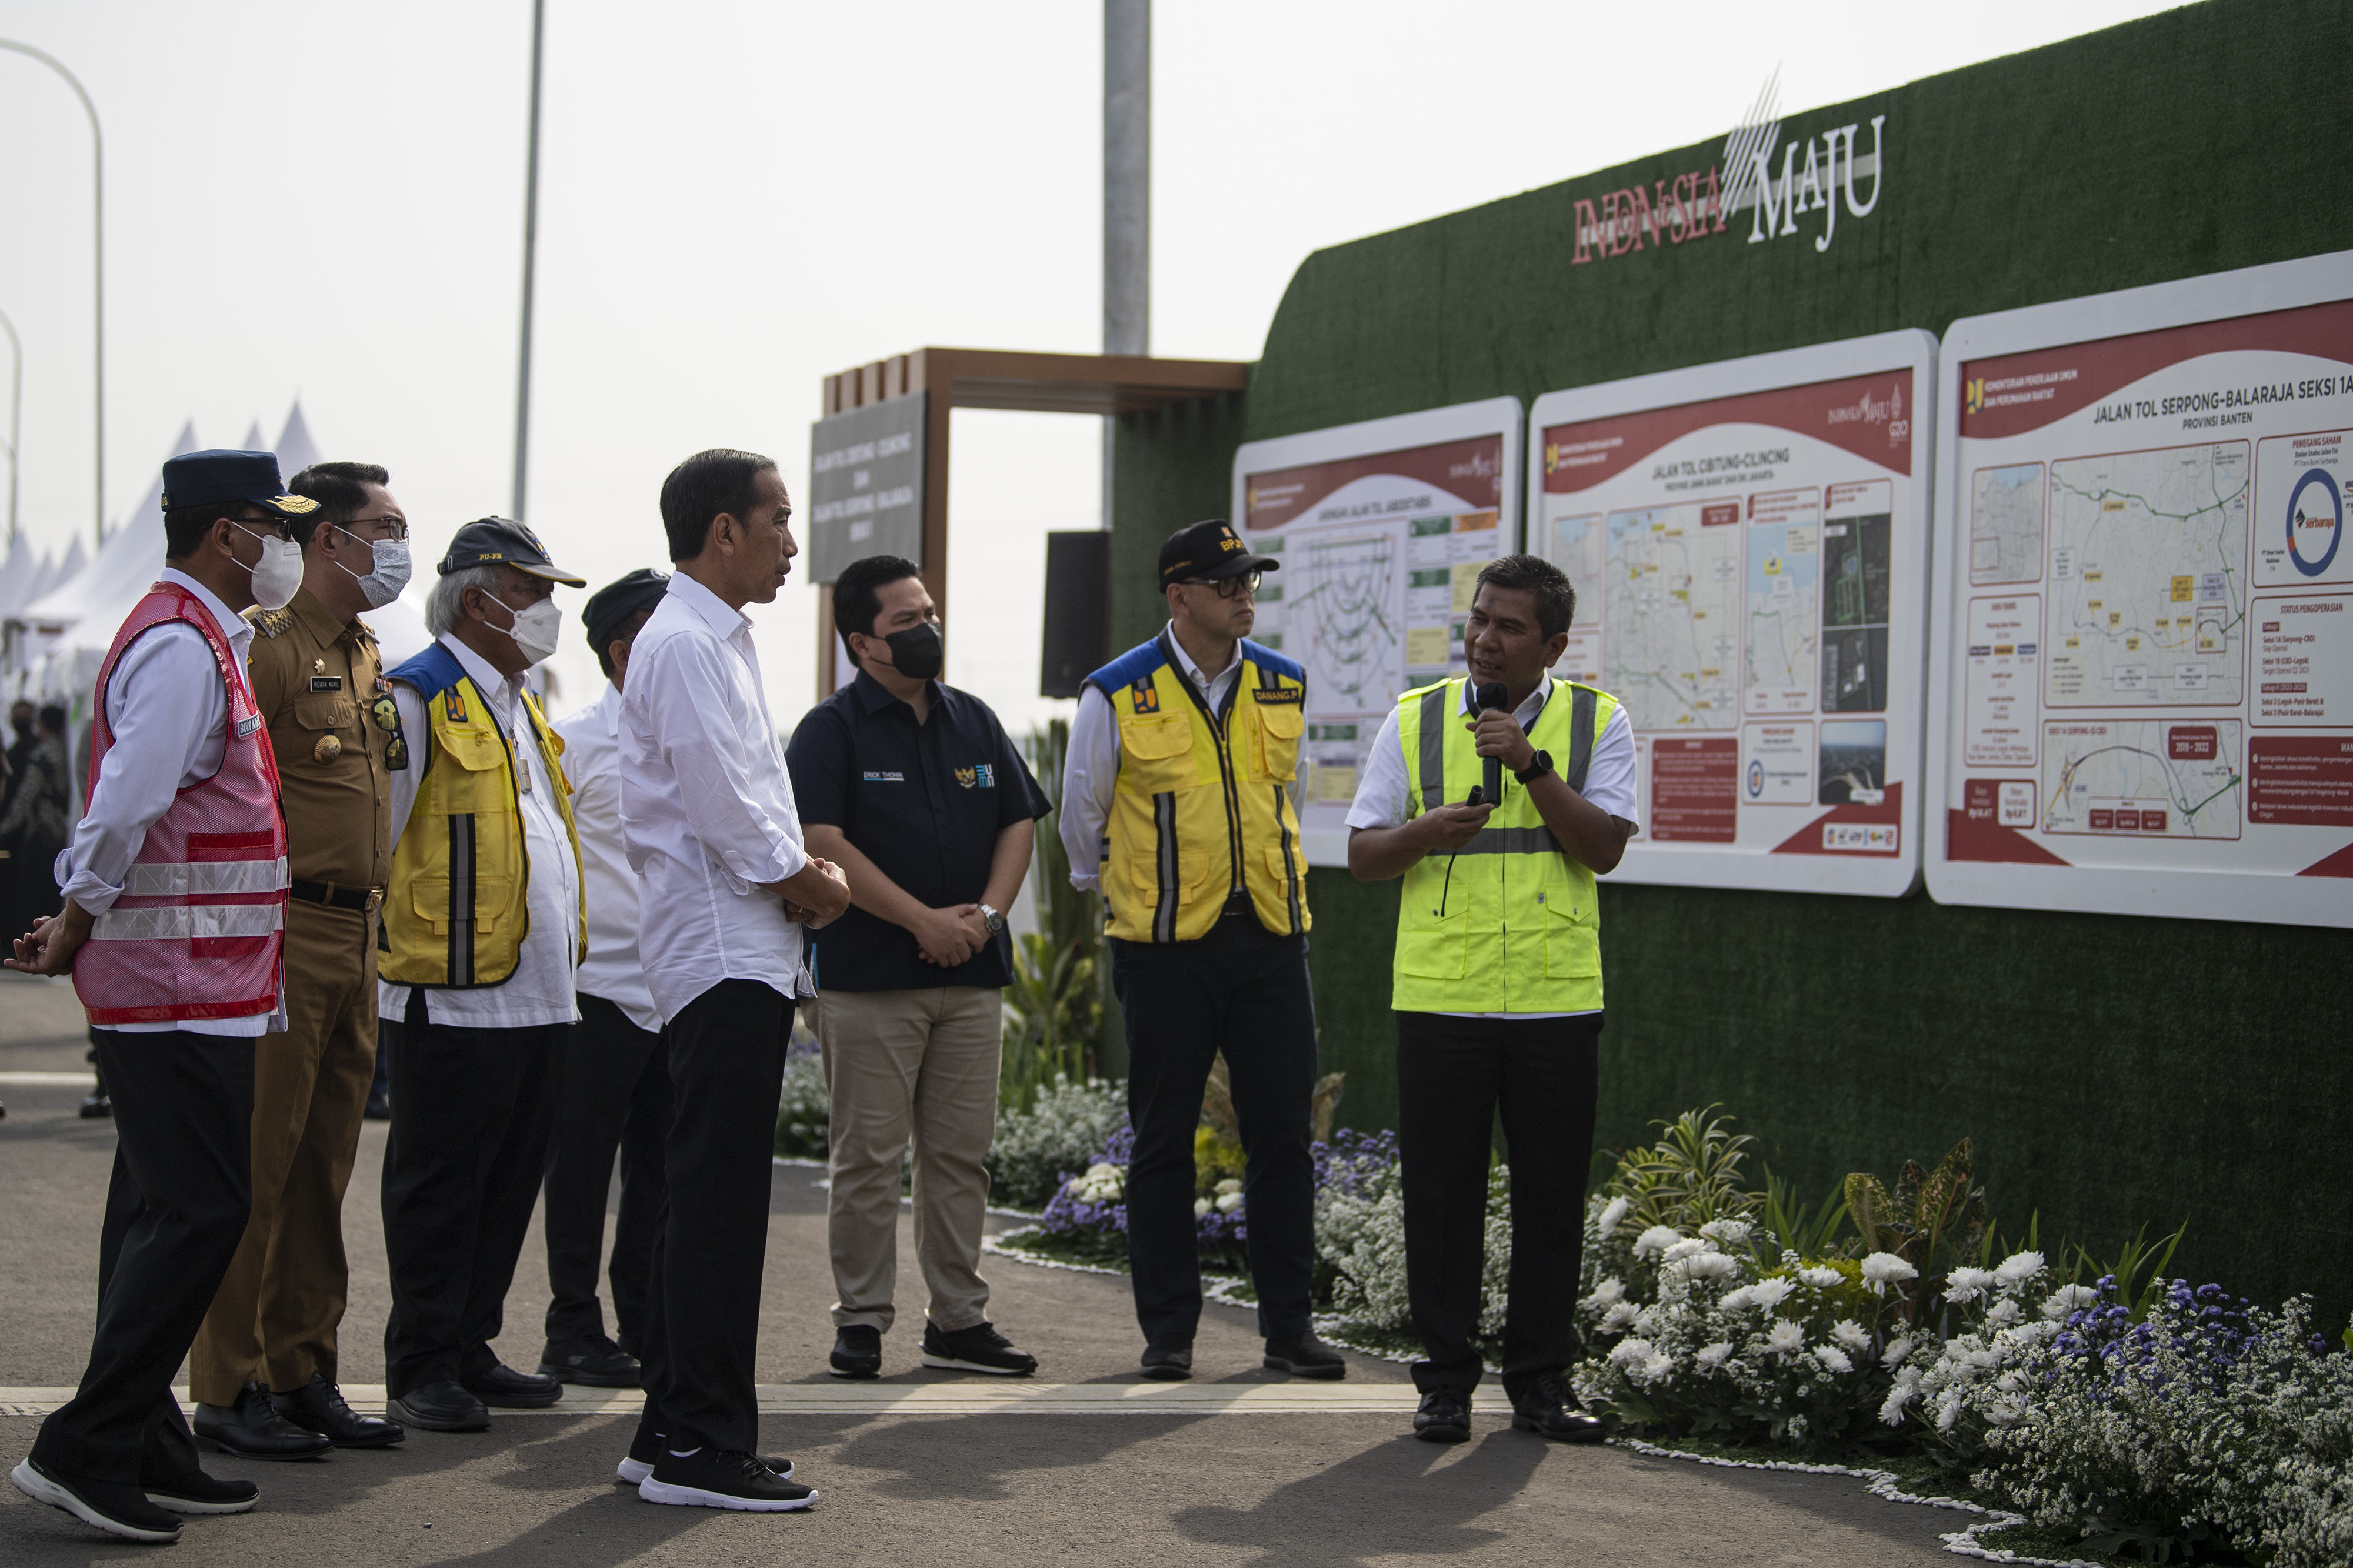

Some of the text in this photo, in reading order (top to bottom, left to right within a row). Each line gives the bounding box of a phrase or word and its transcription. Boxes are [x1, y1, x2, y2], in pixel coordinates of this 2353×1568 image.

[1748, 115, 1885, 252] MAJU
[2094, 403, 2132, 424] JALAN
[2135, 401, 2158, 418] TOL
[2161, 383, 2294, 415] SERPONG-BALARAJA
[2298, 378, 2335, 399] SEKSI
[2182, 412, 2252, 430] PROVINSI BANTEN
[2292, 435, 2342, 449] PEMEGANG SAHAM
[2305, 517, 2334, 529] serbaraja
[2280, 603, 2344, 614] STATUS PENGOPERASIAN
[1256, 690, 1298, 700] DANANG.P
[240, 720, 251, 733] BUDI
